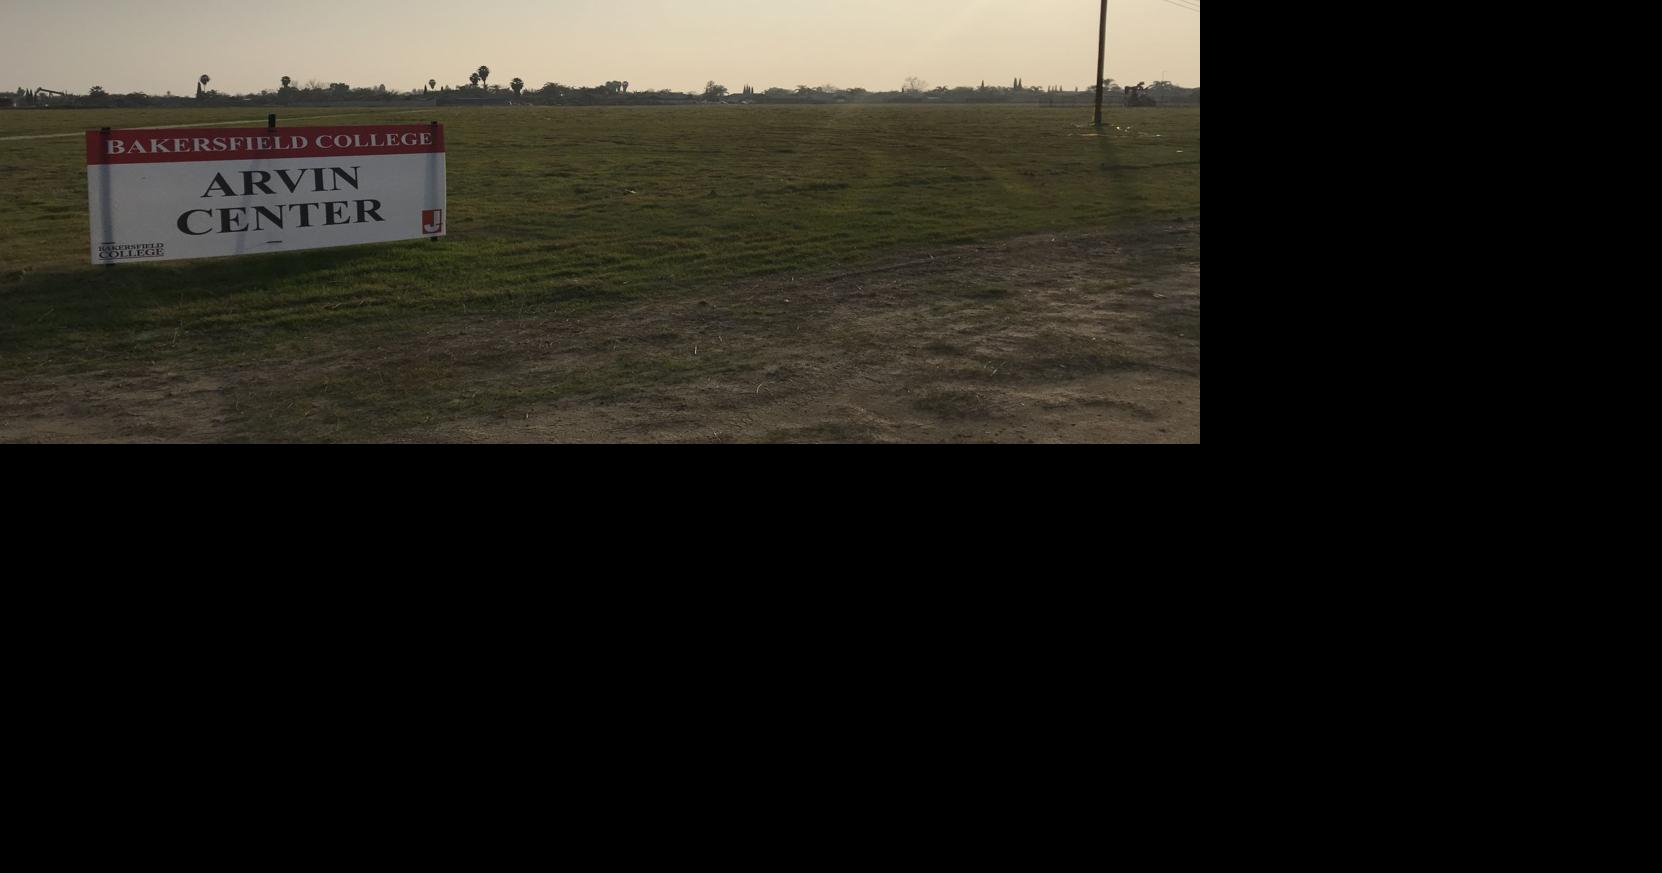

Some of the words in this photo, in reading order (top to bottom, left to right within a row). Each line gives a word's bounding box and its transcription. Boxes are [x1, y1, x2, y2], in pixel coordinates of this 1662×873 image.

[106, 135, 308, 155] BAKERSFIELD
[315, 132, 432, 148] COLLEGE
[201, 166, 360, 198] ARVIN
[177, 199, 385, 235] CENTER
[98, 243, 164, 251] BAKERSFIELD
[99, 249, 164, 258] COLLEGE
